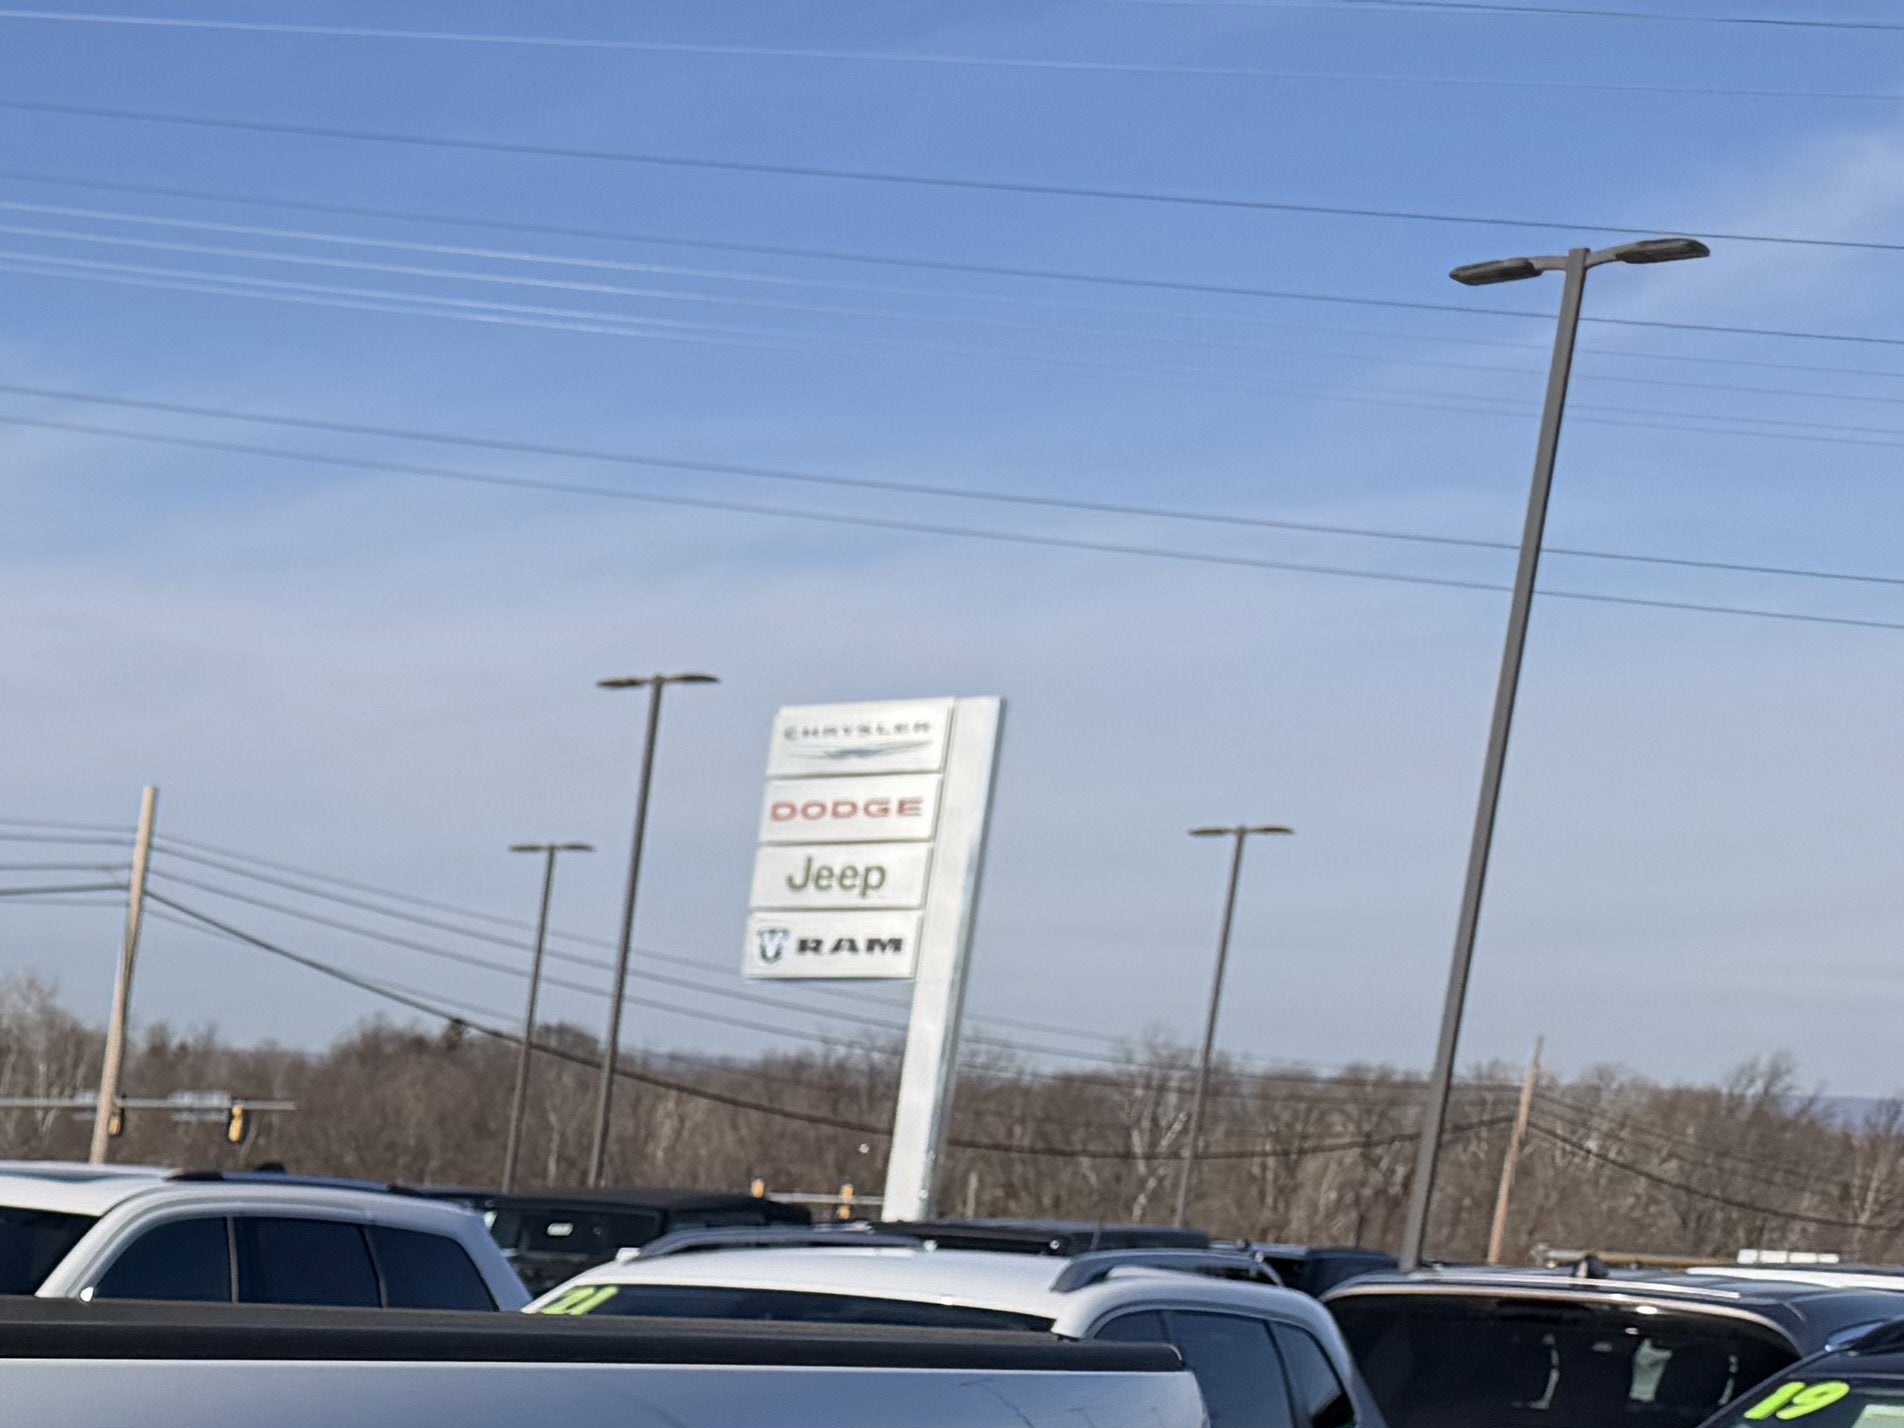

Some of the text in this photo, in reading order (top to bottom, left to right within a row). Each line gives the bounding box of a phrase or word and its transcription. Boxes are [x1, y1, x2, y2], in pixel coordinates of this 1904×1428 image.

[769, 797, 925, 822] DODGE
[786, 855, 887, 899] Jeep
[795, 937, 904, 955] RAM
[1743, 1380, 1851, 1420] 19
